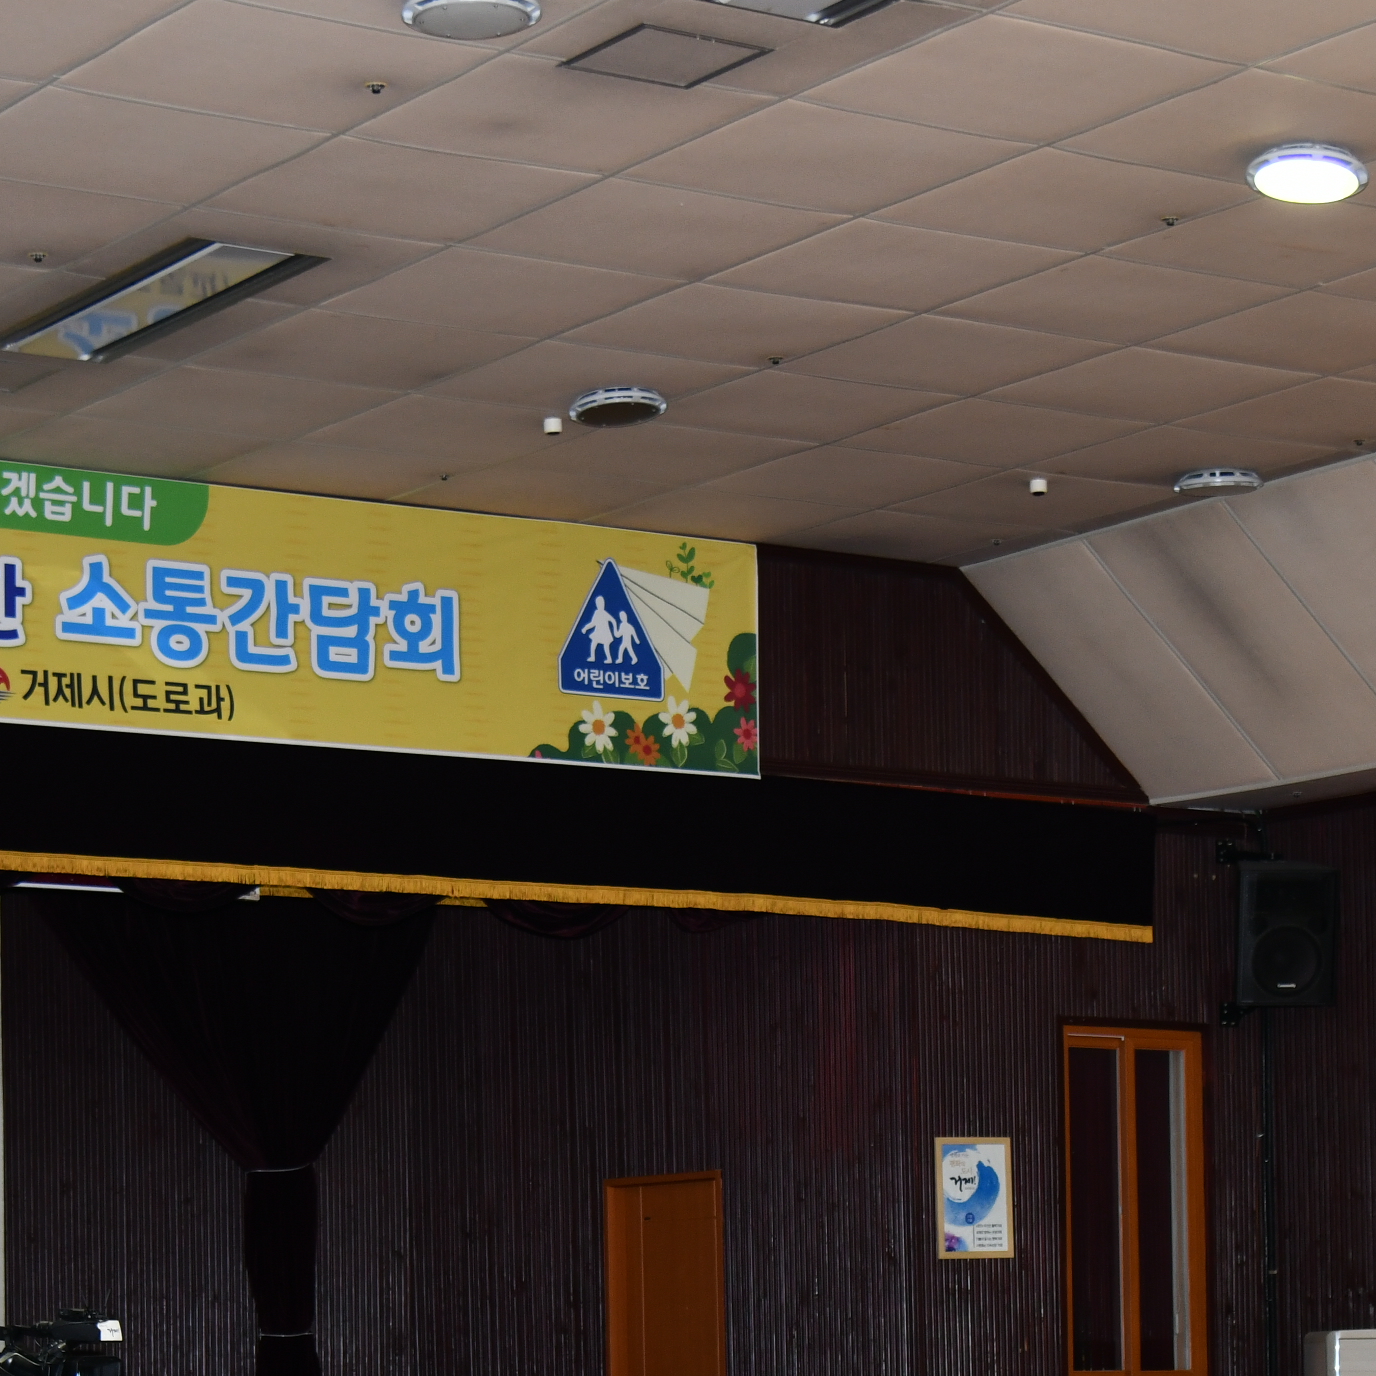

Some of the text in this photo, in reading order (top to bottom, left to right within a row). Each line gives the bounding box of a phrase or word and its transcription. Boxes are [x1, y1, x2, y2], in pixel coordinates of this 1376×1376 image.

[61, 560, 457, 678] 소통간담회
[21, 668, 235, 721] 거제시(도로과)
[574, 668, 650, 690] 어린이보호
